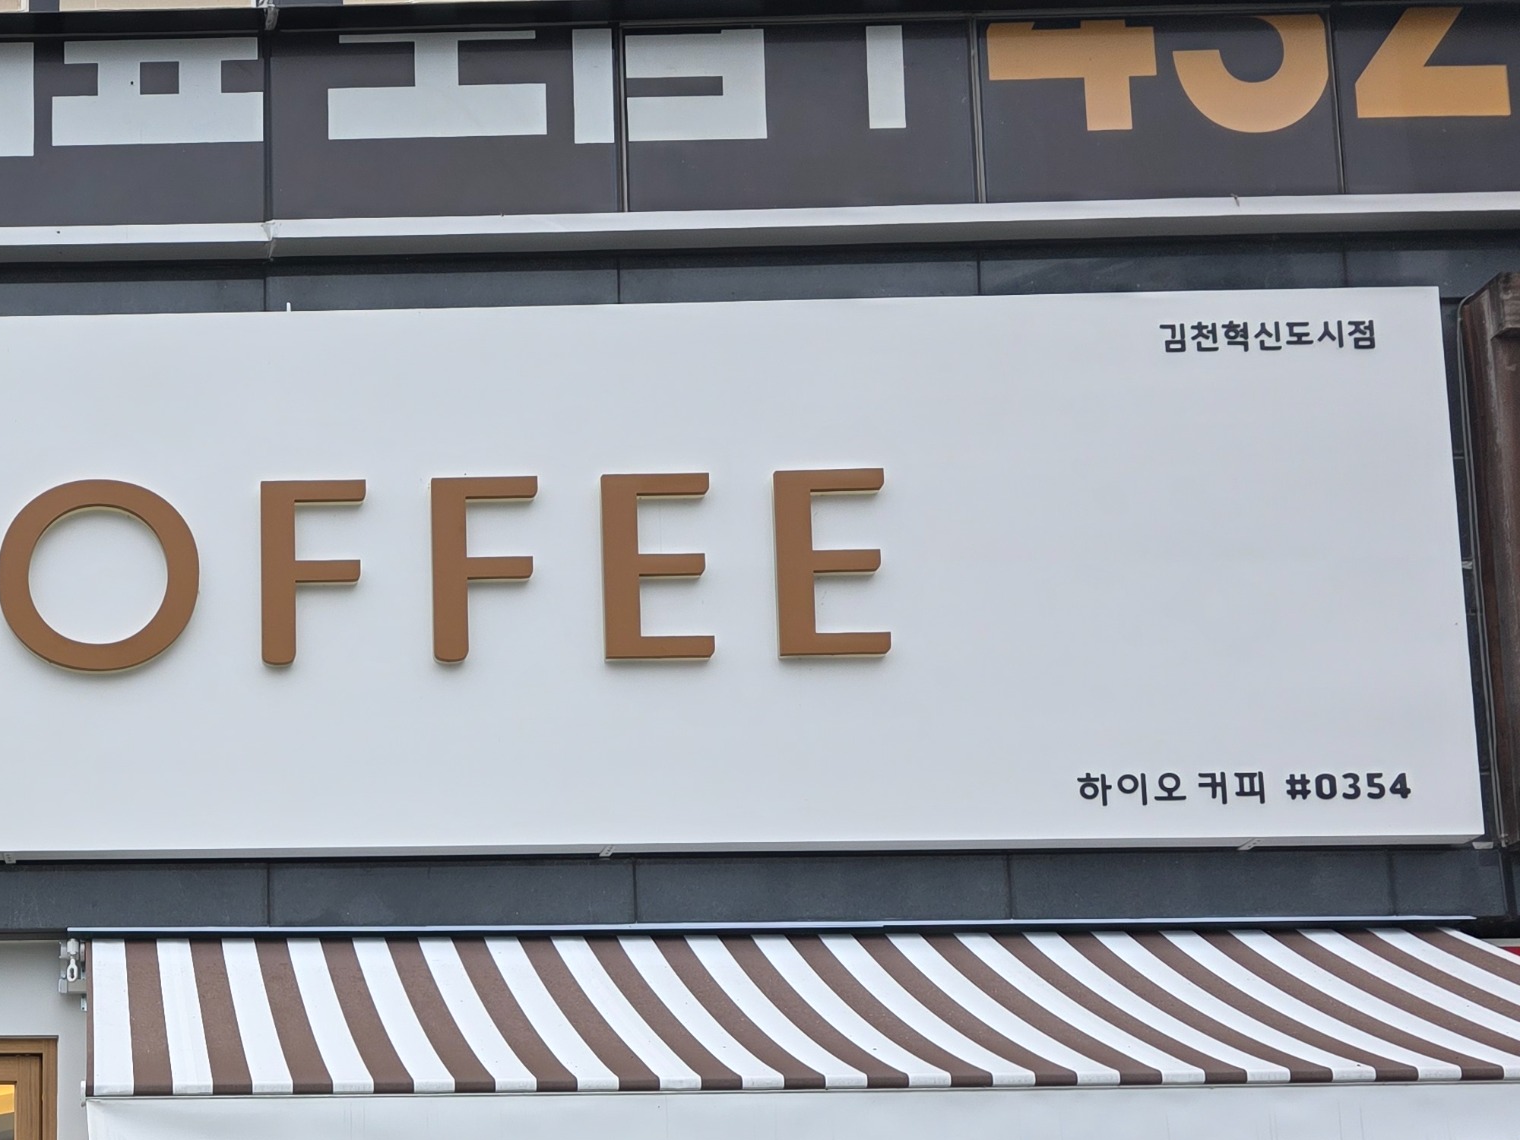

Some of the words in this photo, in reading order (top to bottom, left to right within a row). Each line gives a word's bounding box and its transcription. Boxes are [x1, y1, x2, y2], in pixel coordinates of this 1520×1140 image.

[1159, 319, 1376, 352] 김천혁신도시점
[1077, 772, 1187, 807] 하이오
[1197, 771, 1266, 805] 커피
[1285, 772, 1412, 801] #0354
